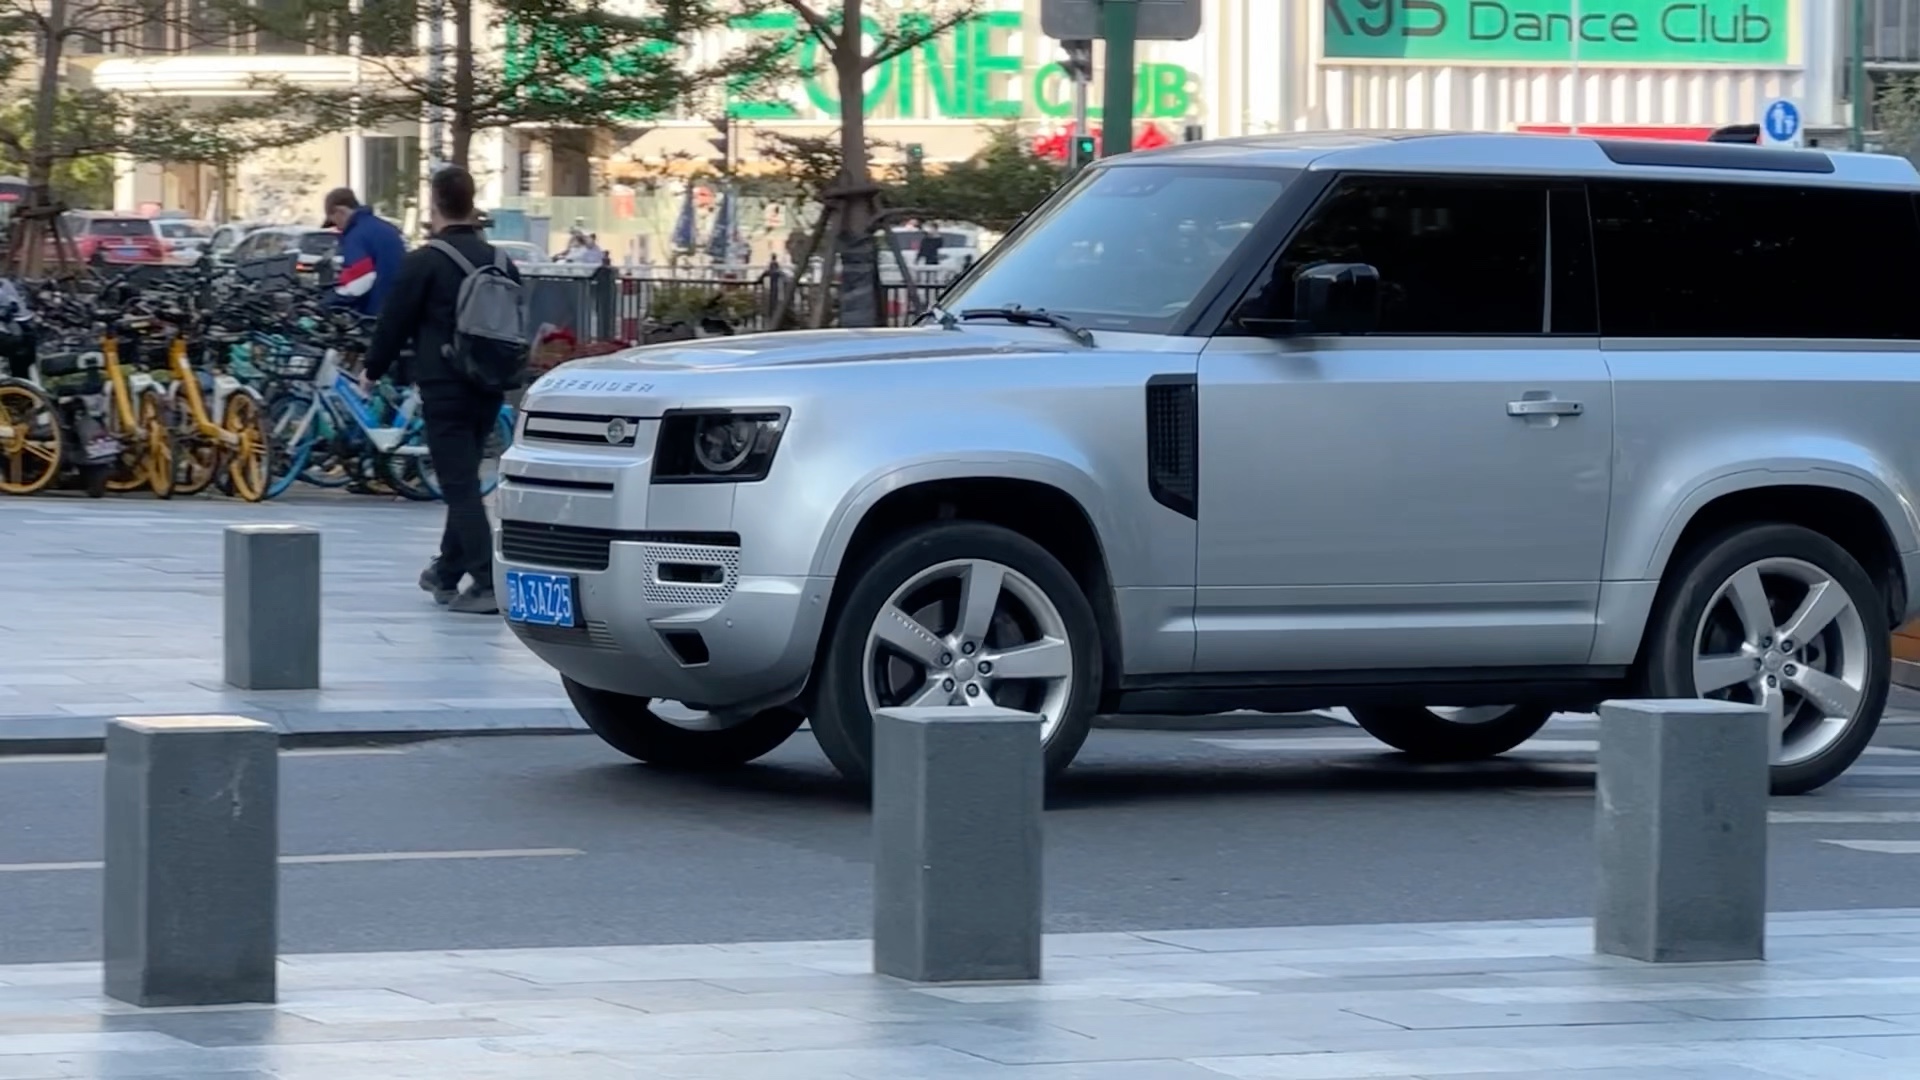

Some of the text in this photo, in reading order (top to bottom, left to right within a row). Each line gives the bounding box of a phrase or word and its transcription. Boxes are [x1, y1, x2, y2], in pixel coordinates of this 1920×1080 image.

[1468, 1, 1639, 42] Dance
[1660, 3, 1771, 43] Club
[727, 11, 1022, 117] ZONE
[1033, 62, 1189, 117] CB
